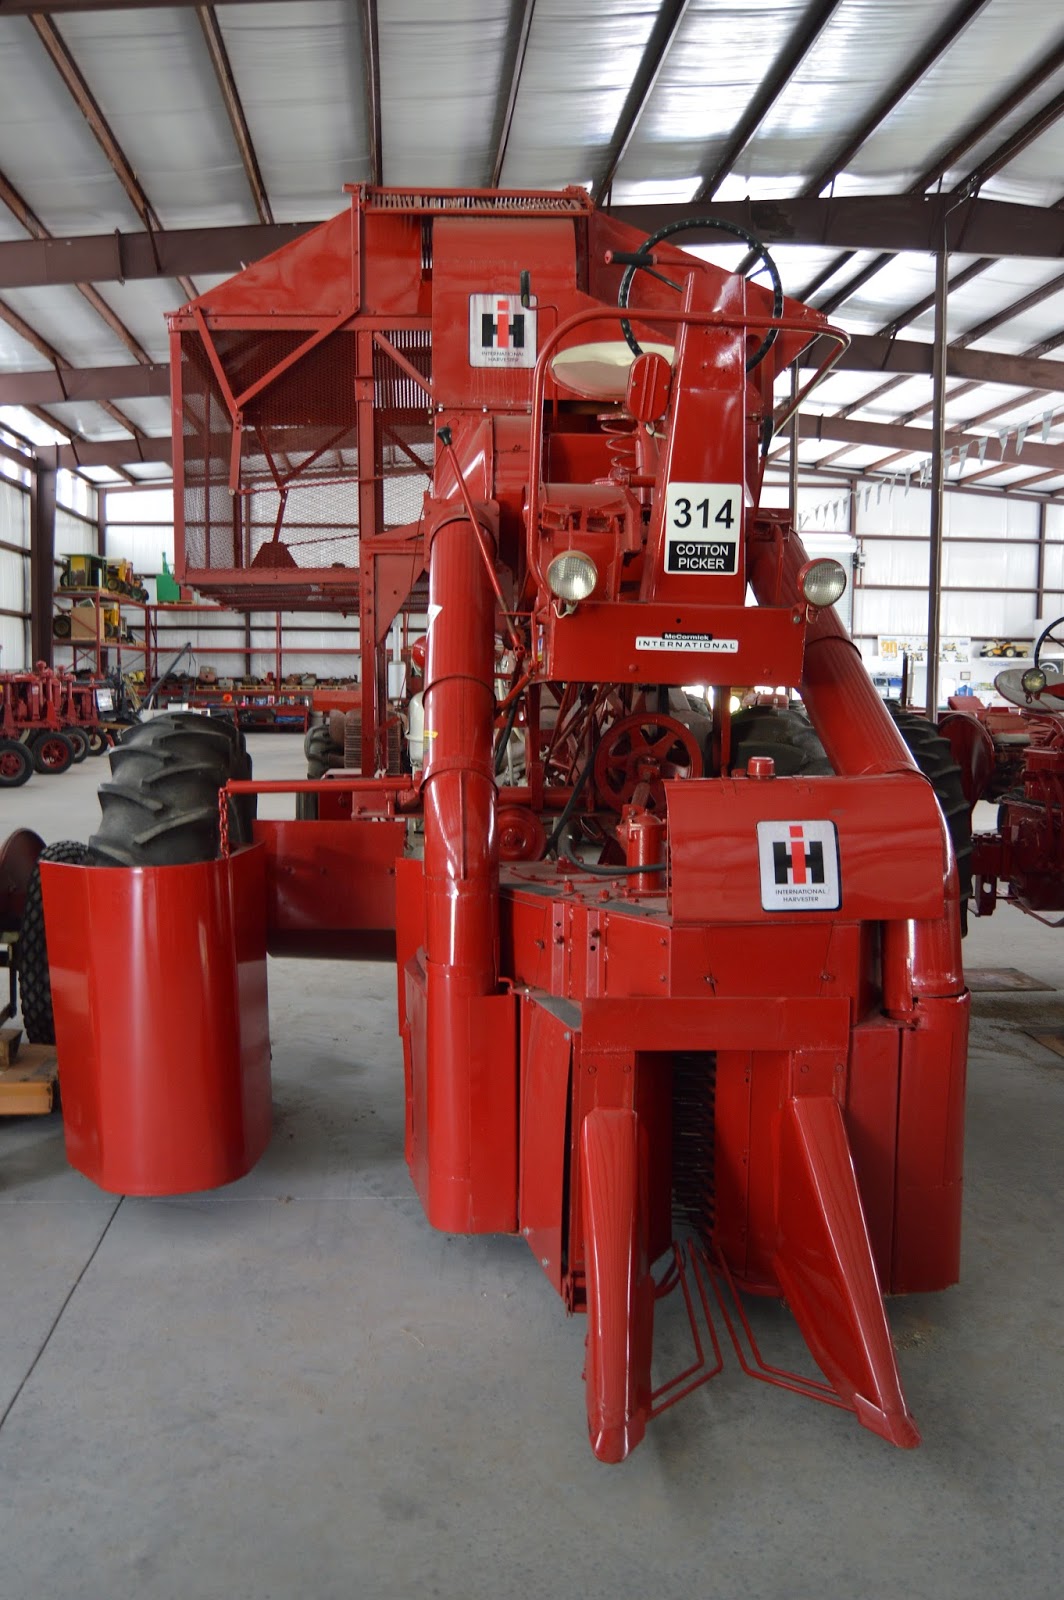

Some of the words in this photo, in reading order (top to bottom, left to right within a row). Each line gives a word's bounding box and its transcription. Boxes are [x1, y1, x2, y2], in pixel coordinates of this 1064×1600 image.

[673, 497, 735, 530] 314
[676, 543, 729, 556] COTTON
[678, 557, 725, 570] PICKER
[664, 632, 710, 641] McCormick
[638, 640, 736, 650] INTERNATIONAL
